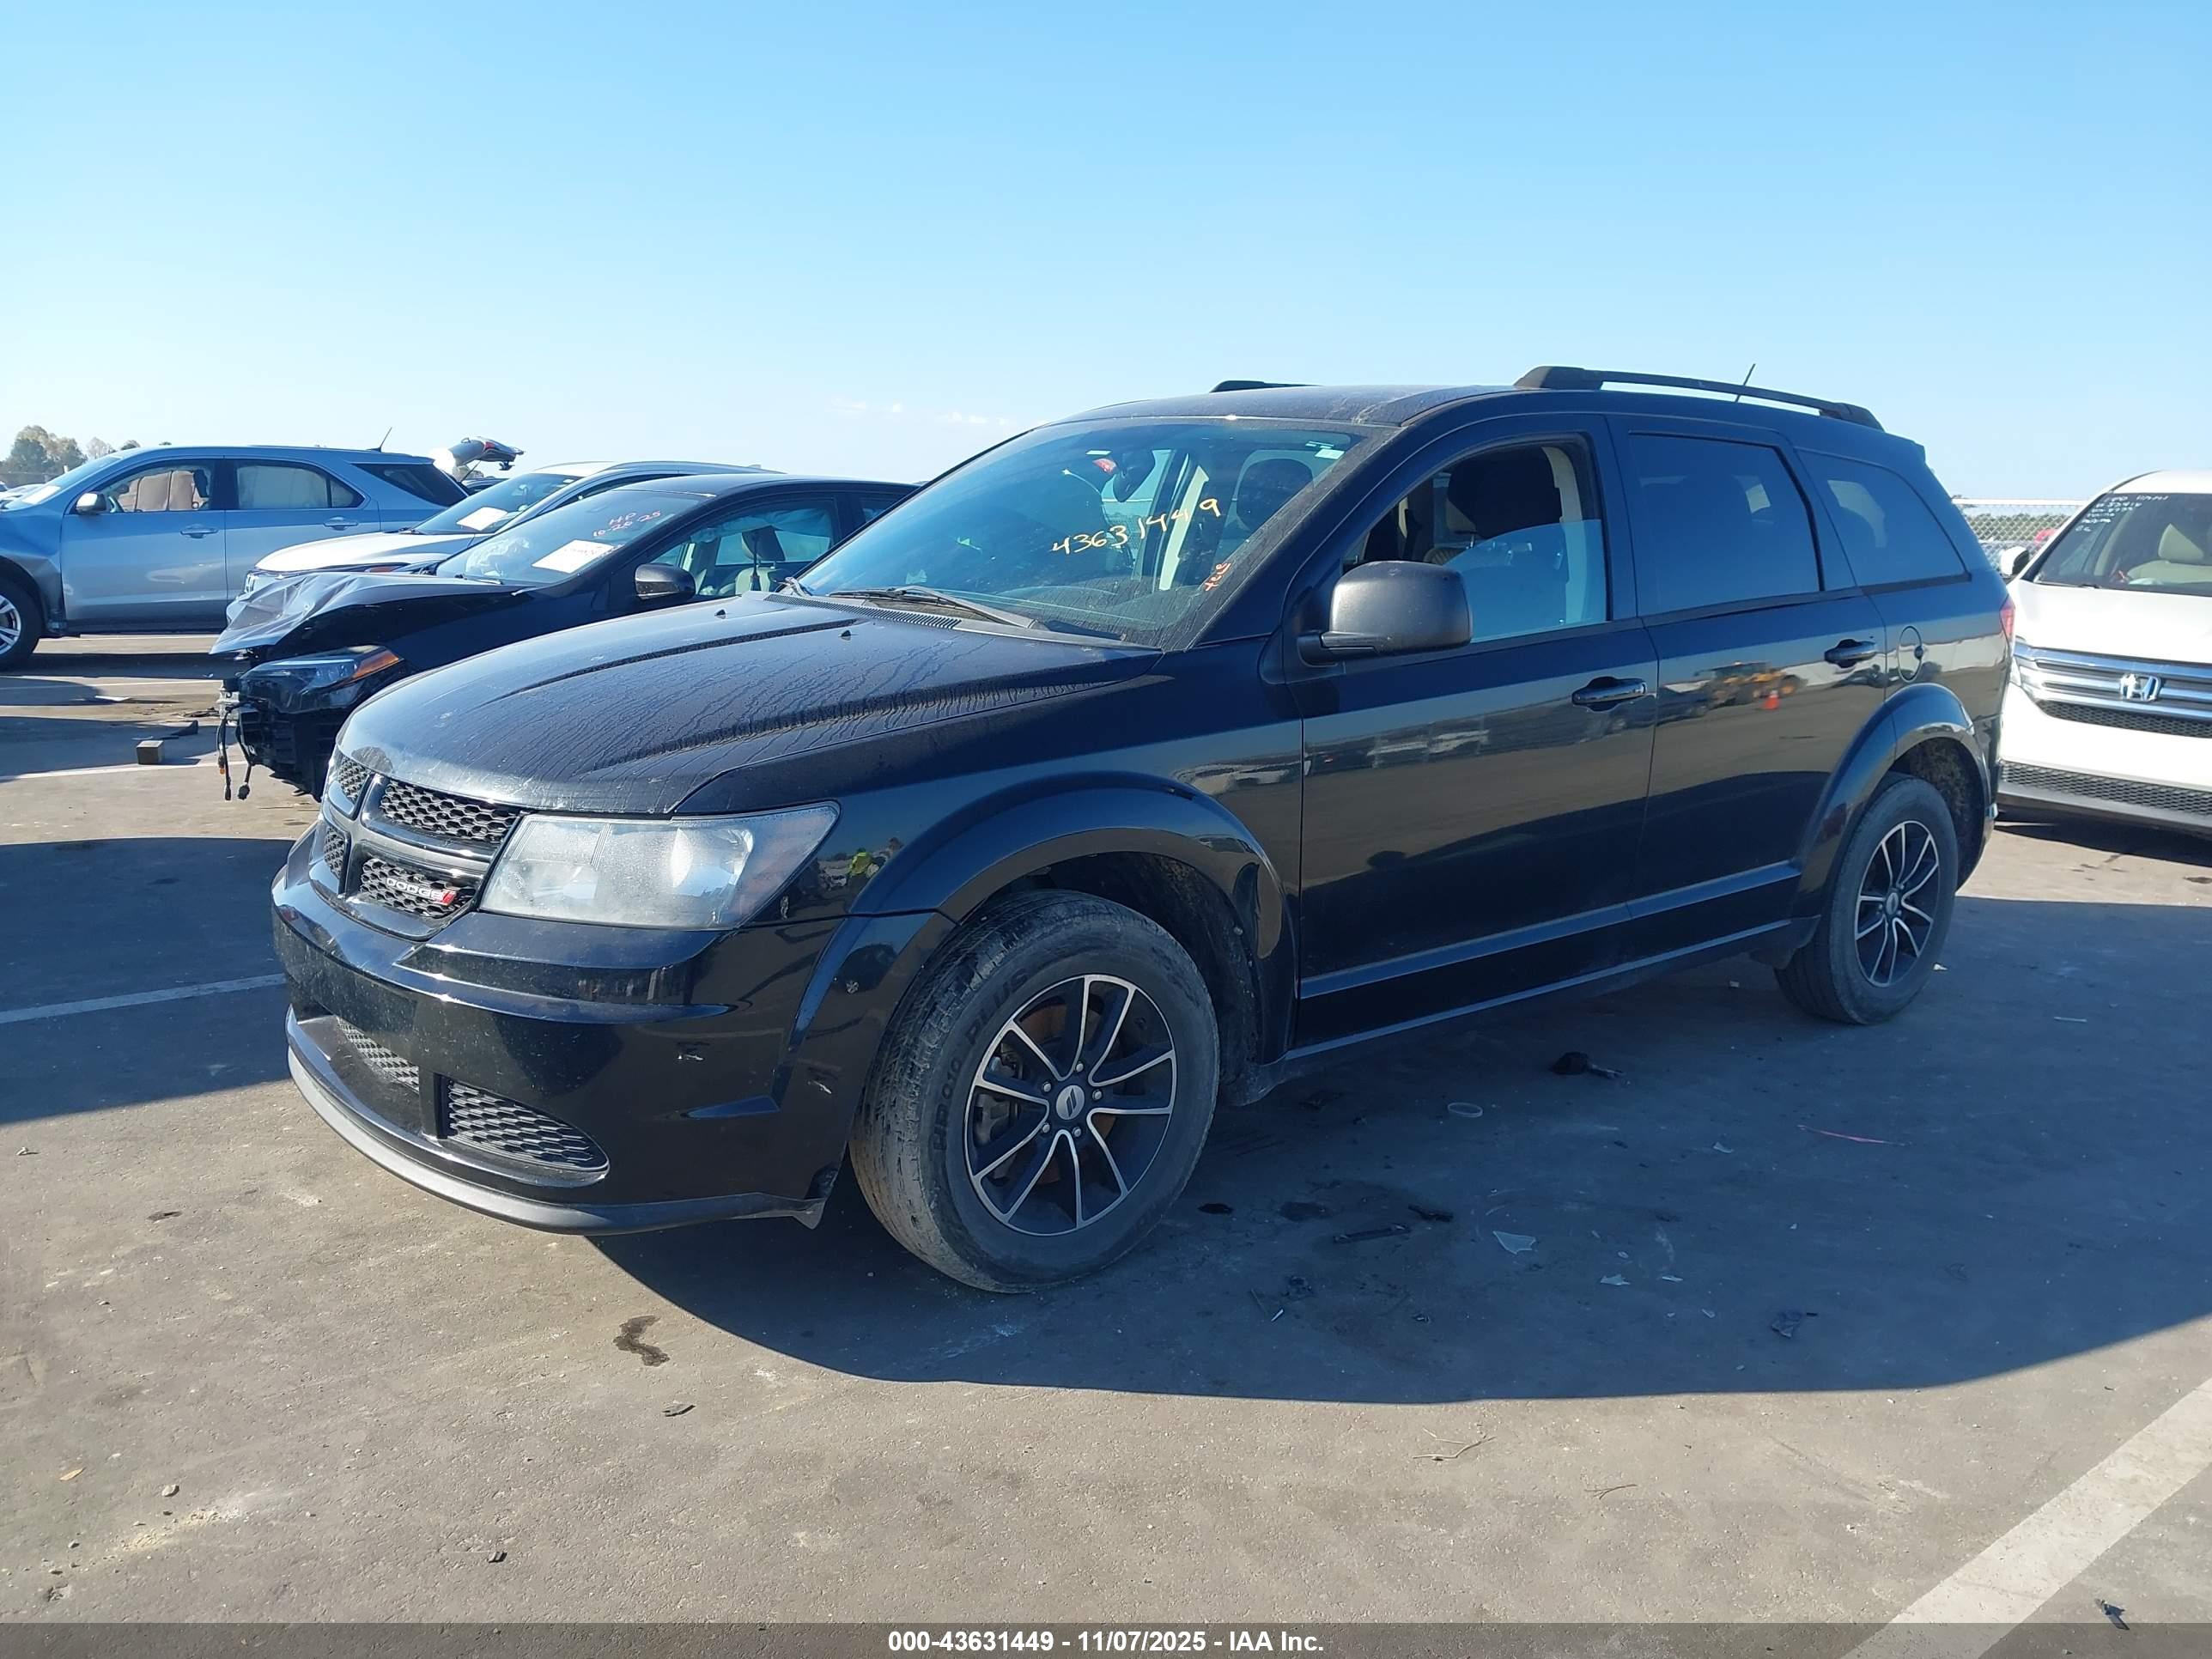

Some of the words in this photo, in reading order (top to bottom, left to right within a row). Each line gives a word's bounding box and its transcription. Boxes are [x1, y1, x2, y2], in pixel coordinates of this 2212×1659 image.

[1051, 498, 1221, 555] 43631449
[386, 877, 443, 902] DODGE
[964, 967, 1030, 1045] PLUS
